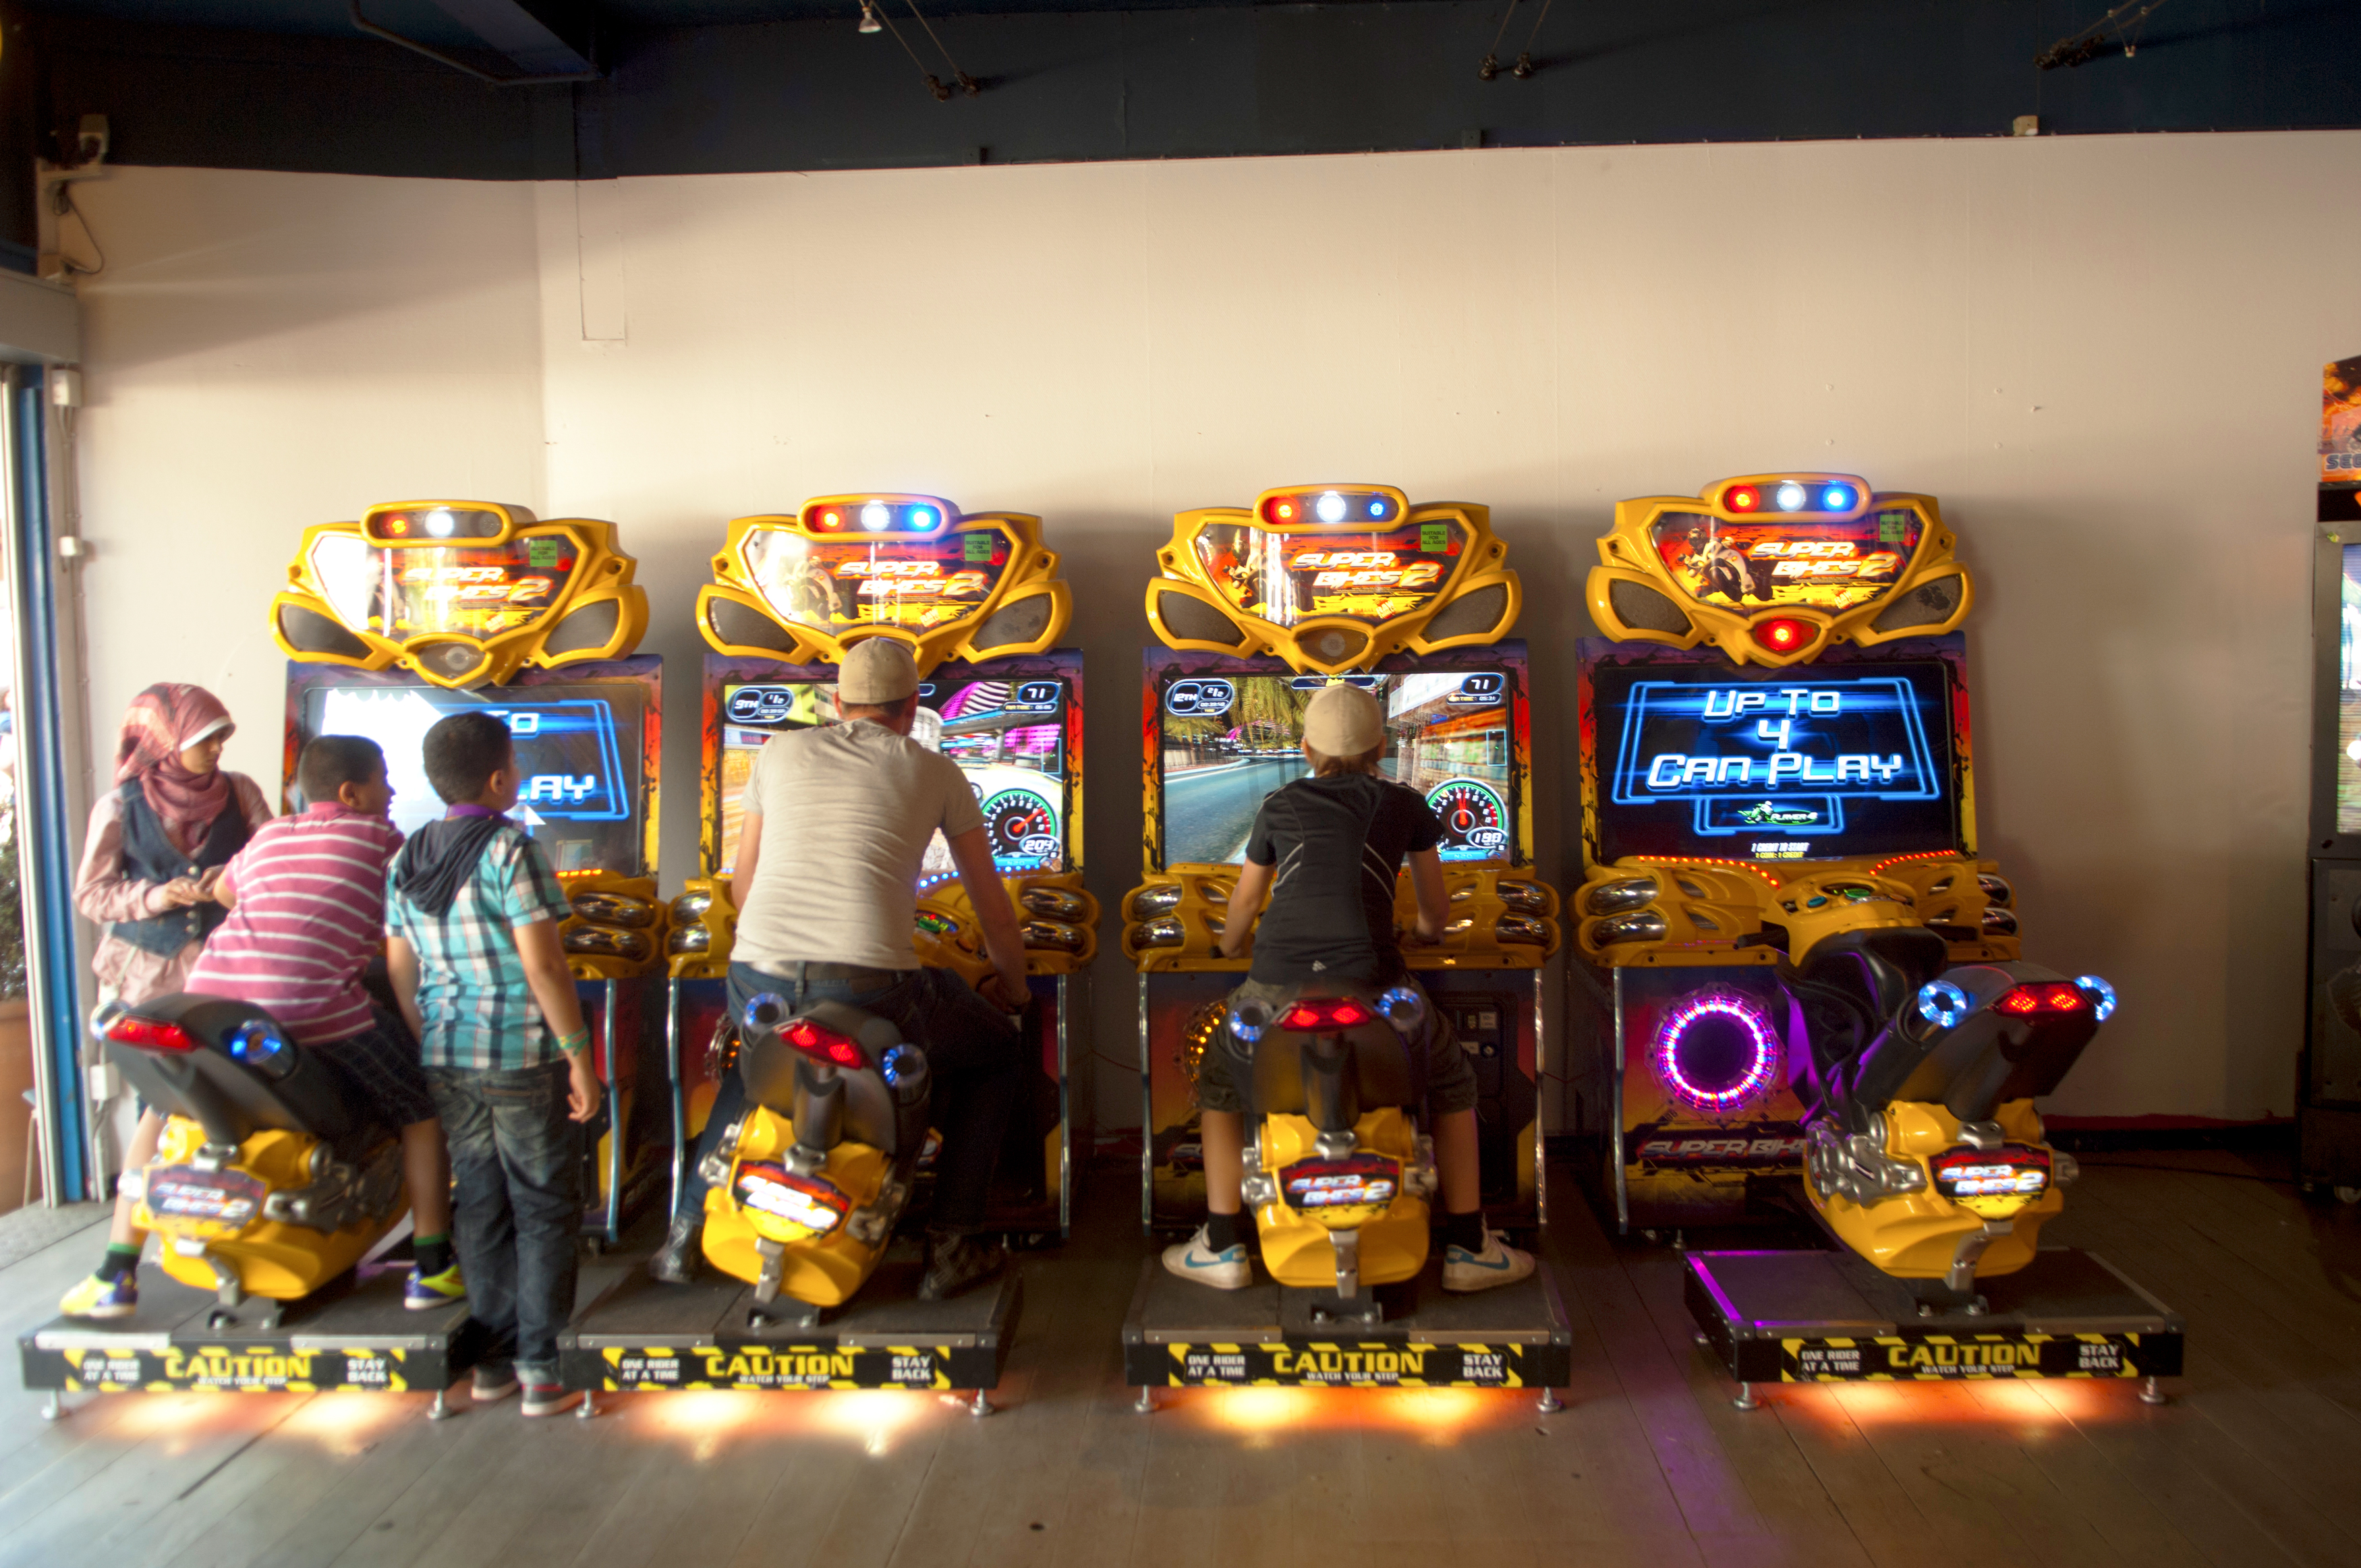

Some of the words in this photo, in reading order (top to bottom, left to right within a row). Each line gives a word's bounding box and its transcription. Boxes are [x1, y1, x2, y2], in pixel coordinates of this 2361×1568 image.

[1751, 542, 1856, 559] SUPER
[1292, 552, 1397, 570] SUPER
[1771, 561, 1862, 579] BIKES
[1858, 554, 1898, 577] 2
[837, 561, 940, 577] SUPER
[1312, 571, 1403, 589] BIKES
[1400, 563, 1441, 587] 2
[507, 578, 551, 602] 2
[944, 573, 984, 596] 2
[1471, 678, 1489, 690] 71
[1027, 688, 1046, 699] 71
[1174, 693, 1198, 702] 12TH
[734, 699, 760, 709] 9TH
[1704, 690, 1765, 718] UP
[1781, 689, 1840, 716] TO
[1757, 719, 1791, 751] 4
[1767, 753, 1902, 788] PLAY
[1751, 843, 1757, 852] 1
[1757, 842, 1780, 852] CREDIT
[1779, 842, 1788, 852] TO
[1788, 842, 1810, 852] START
[1641, 1140, 1748, 1159] SUPER
[1940, 1164, 2013, 1180] SUPER
[1289, 1174, 1361, 1191] SUPER
[2016, 1171, 2045, 1192] 2
[1363, 1180, 1392, 1202] 2
[219, 1198, 252, 1217] 2
[1801, 1350, 1824, 1360] ONE
[1827, 1350, 1860, 1360] RIDER
[1889, 1345, 2040, 1367] CAUTION
[2079, 1344, 2119, 1356] STAY
[83, 1359, 105, 1370] ONE
[107, 1358, 140, 1370] RIDER
[347, 1358, 387, 1370] STAY
[621, 1359, 644, 1369] ONE
[647, 1358, 680, 1369] RIDER
[706, 1355, 854, 1376] CAUTION
[892, 1356, 931, 1368] STAY
[1188, 1355, 1210, 1366] ONE
[1213, 1355, 1245, 1365] RIDER
[1274, 1352, 1423, 1373] CAUTION
[1462, 1354, 1503, 1366] STAY
[2079, 1356, 2120, 1368] BACK
[165, 1356, 311, 1377] CAUTION
[1188, 1366, 1203, 1376] AT
[1206, 1366, 1216, 1376] A
[1220, 1366, 1245, 1376] TIME
[1462, 1366, 1504, 1378] BACK
[1801, 1361, 1817, 1372] AT
[1819, 1361, 1830, 1372] A
[1833, 1361, 1860, 1371] TIME
[1921, 1366, 1957, 1374] WATCH
[1960, 1365, 1988, 1373] YOUR
[1990, 1364, 2015, 1373] STEP
[83, 1371, 101, 1381] AT
[101, 1371, 113, 1381] A
[114, 1371, 140, 1381] TIME
[197, 1376, 231, 1385] WATCH
[234, 1376, 261, 1385] YOUR
[262, 1376, 287, 1385] STEP
[347, 1371, 387, 1383] BACK
[622, 1370, 638, 1381] AT
[640, 1370, 651, 1381] A
[653, 1370, 680, 1380] TIME
[738, 1374, 774, 1383] WATCH
[776, 1374, 803, 1383] YOUR
[805, 1374, 831, 1383] STEP
[891, 1368, 931, 1381] BACK
[1306, 1372, 1342, 1381] WATCH
[1344, 1372, 1371, 1381] YOUR
[1374, 1372, 1399, 1381] STEP
